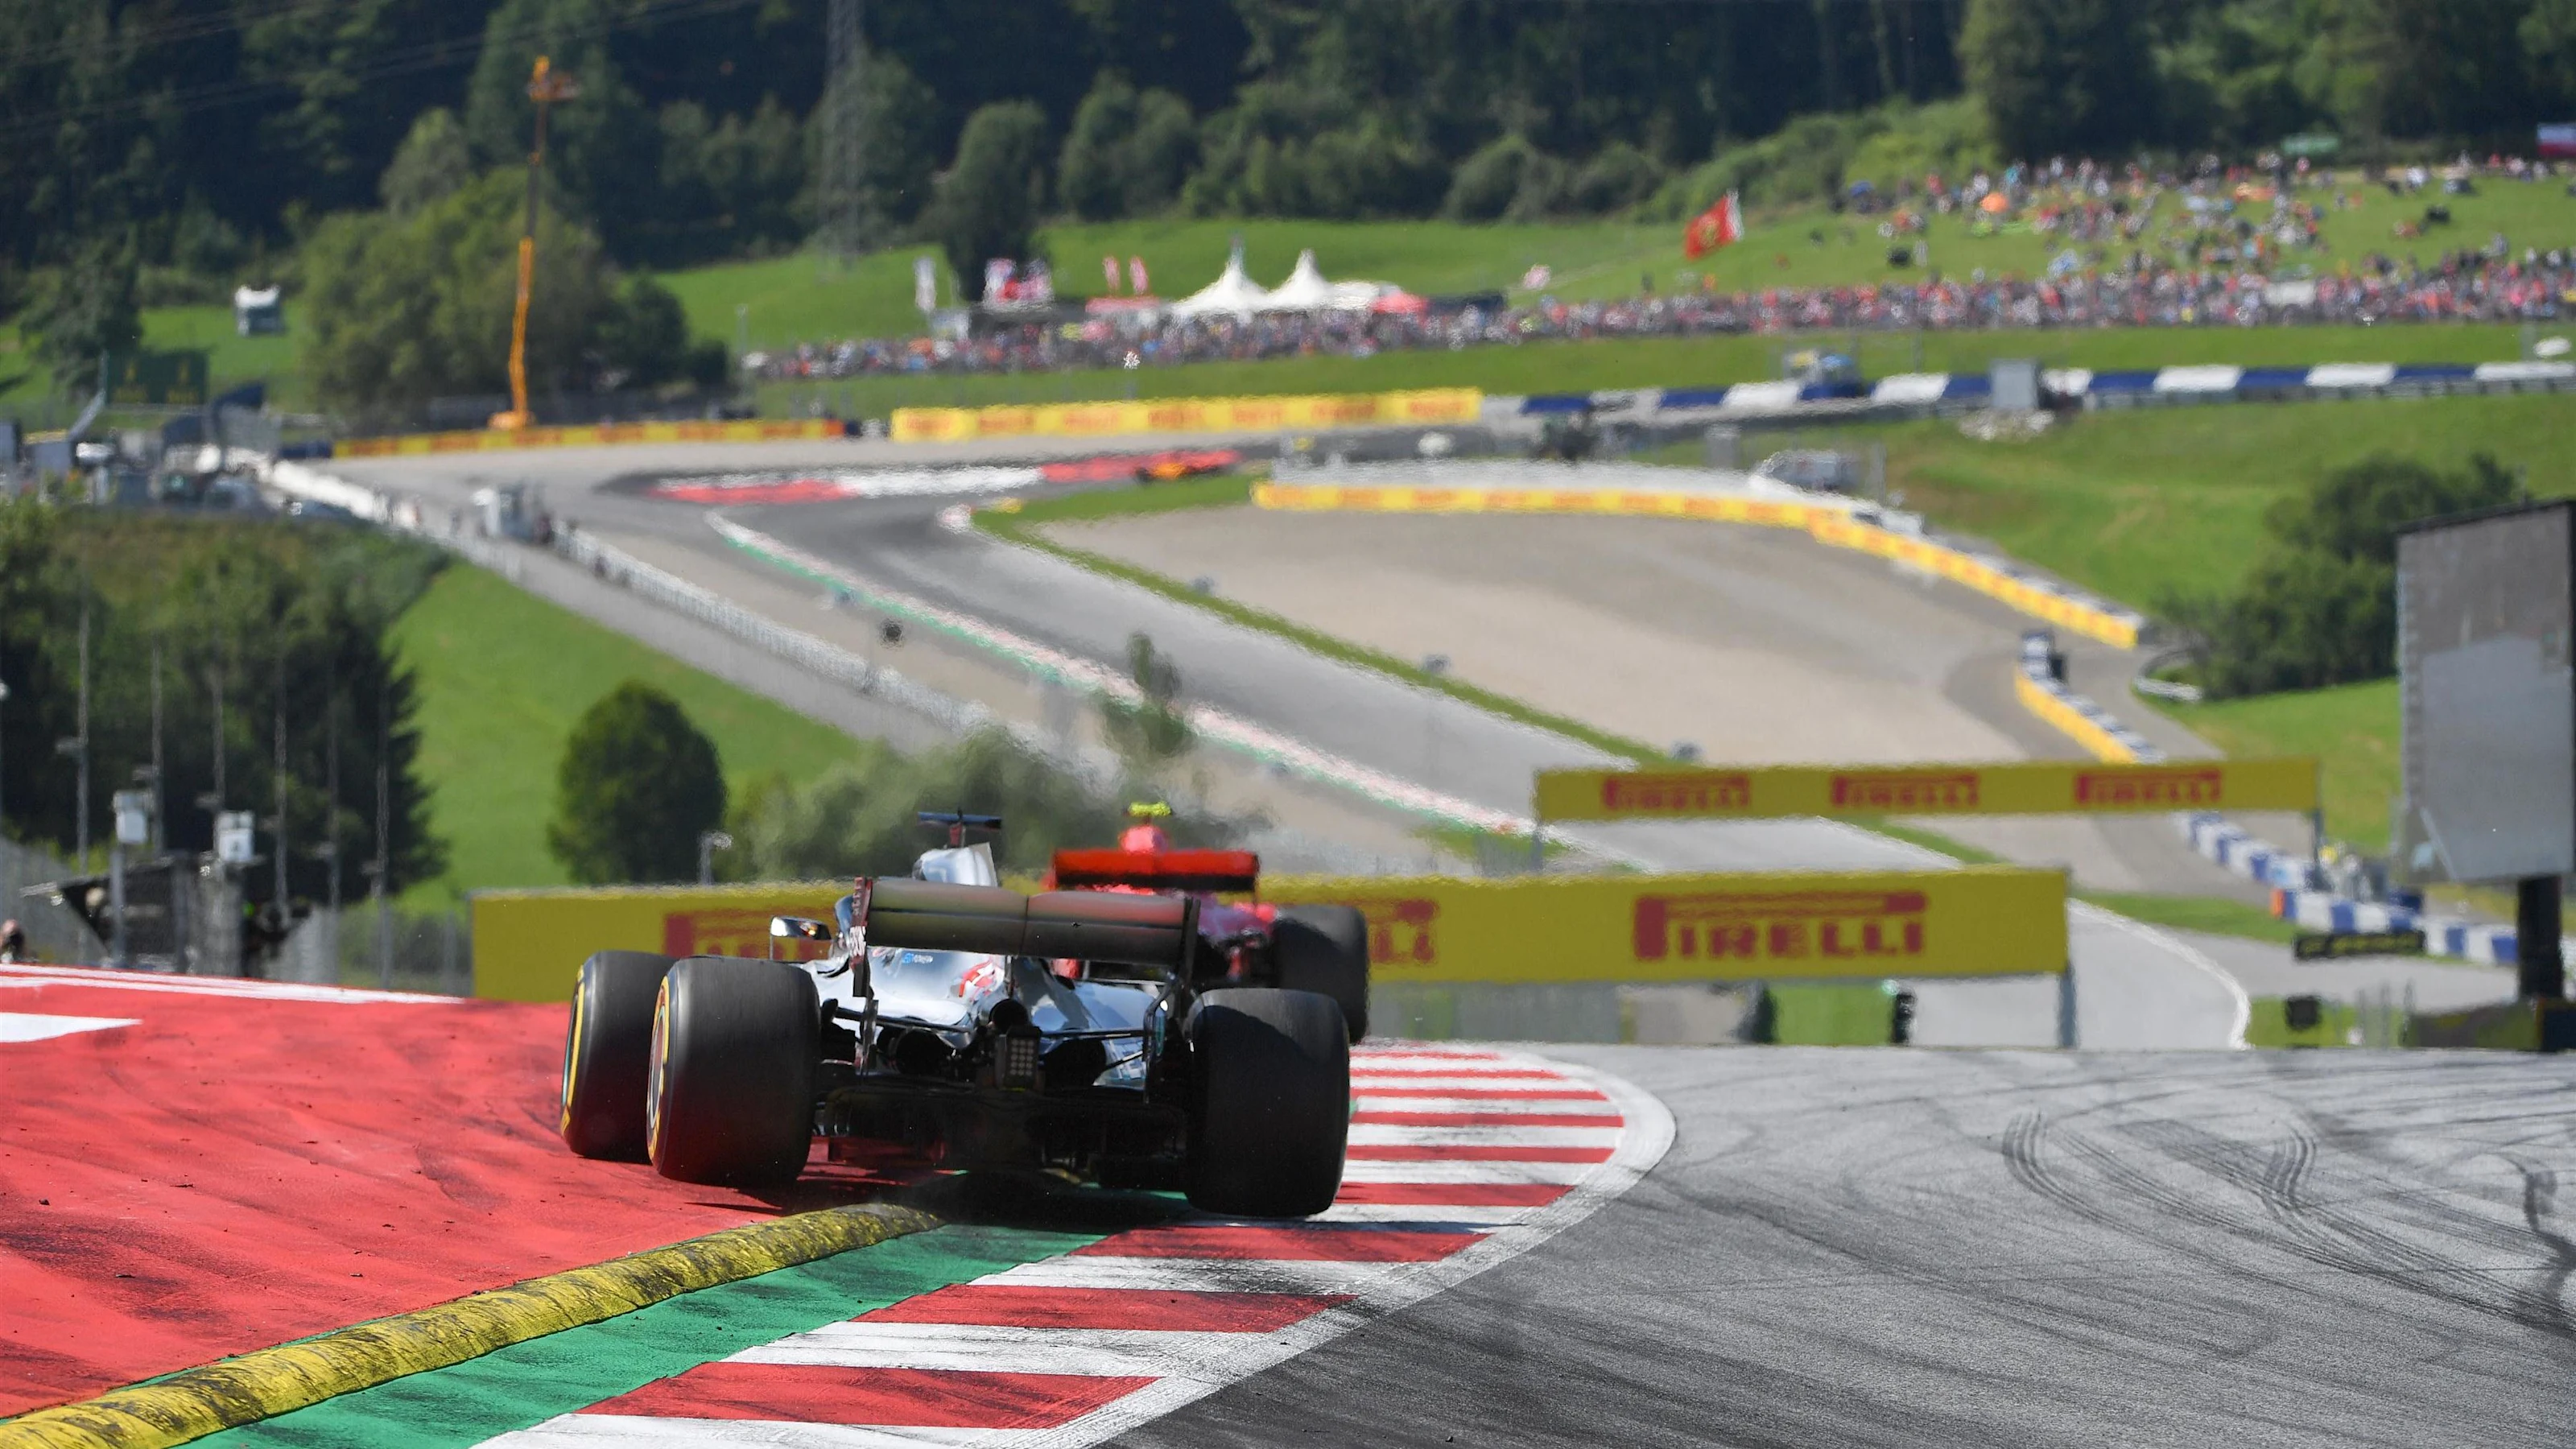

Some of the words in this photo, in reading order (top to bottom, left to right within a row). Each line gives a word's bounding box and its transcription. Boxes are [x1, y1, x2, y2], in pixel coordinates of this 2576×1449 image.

[1603, 775, 1749, 809] PIRELLI
[1831, 773, 1979, 807] PIRELLI
[2074, 770, 2222, 805] PIRELLI
[1634, 892, 1927, 960] PIRELLI
